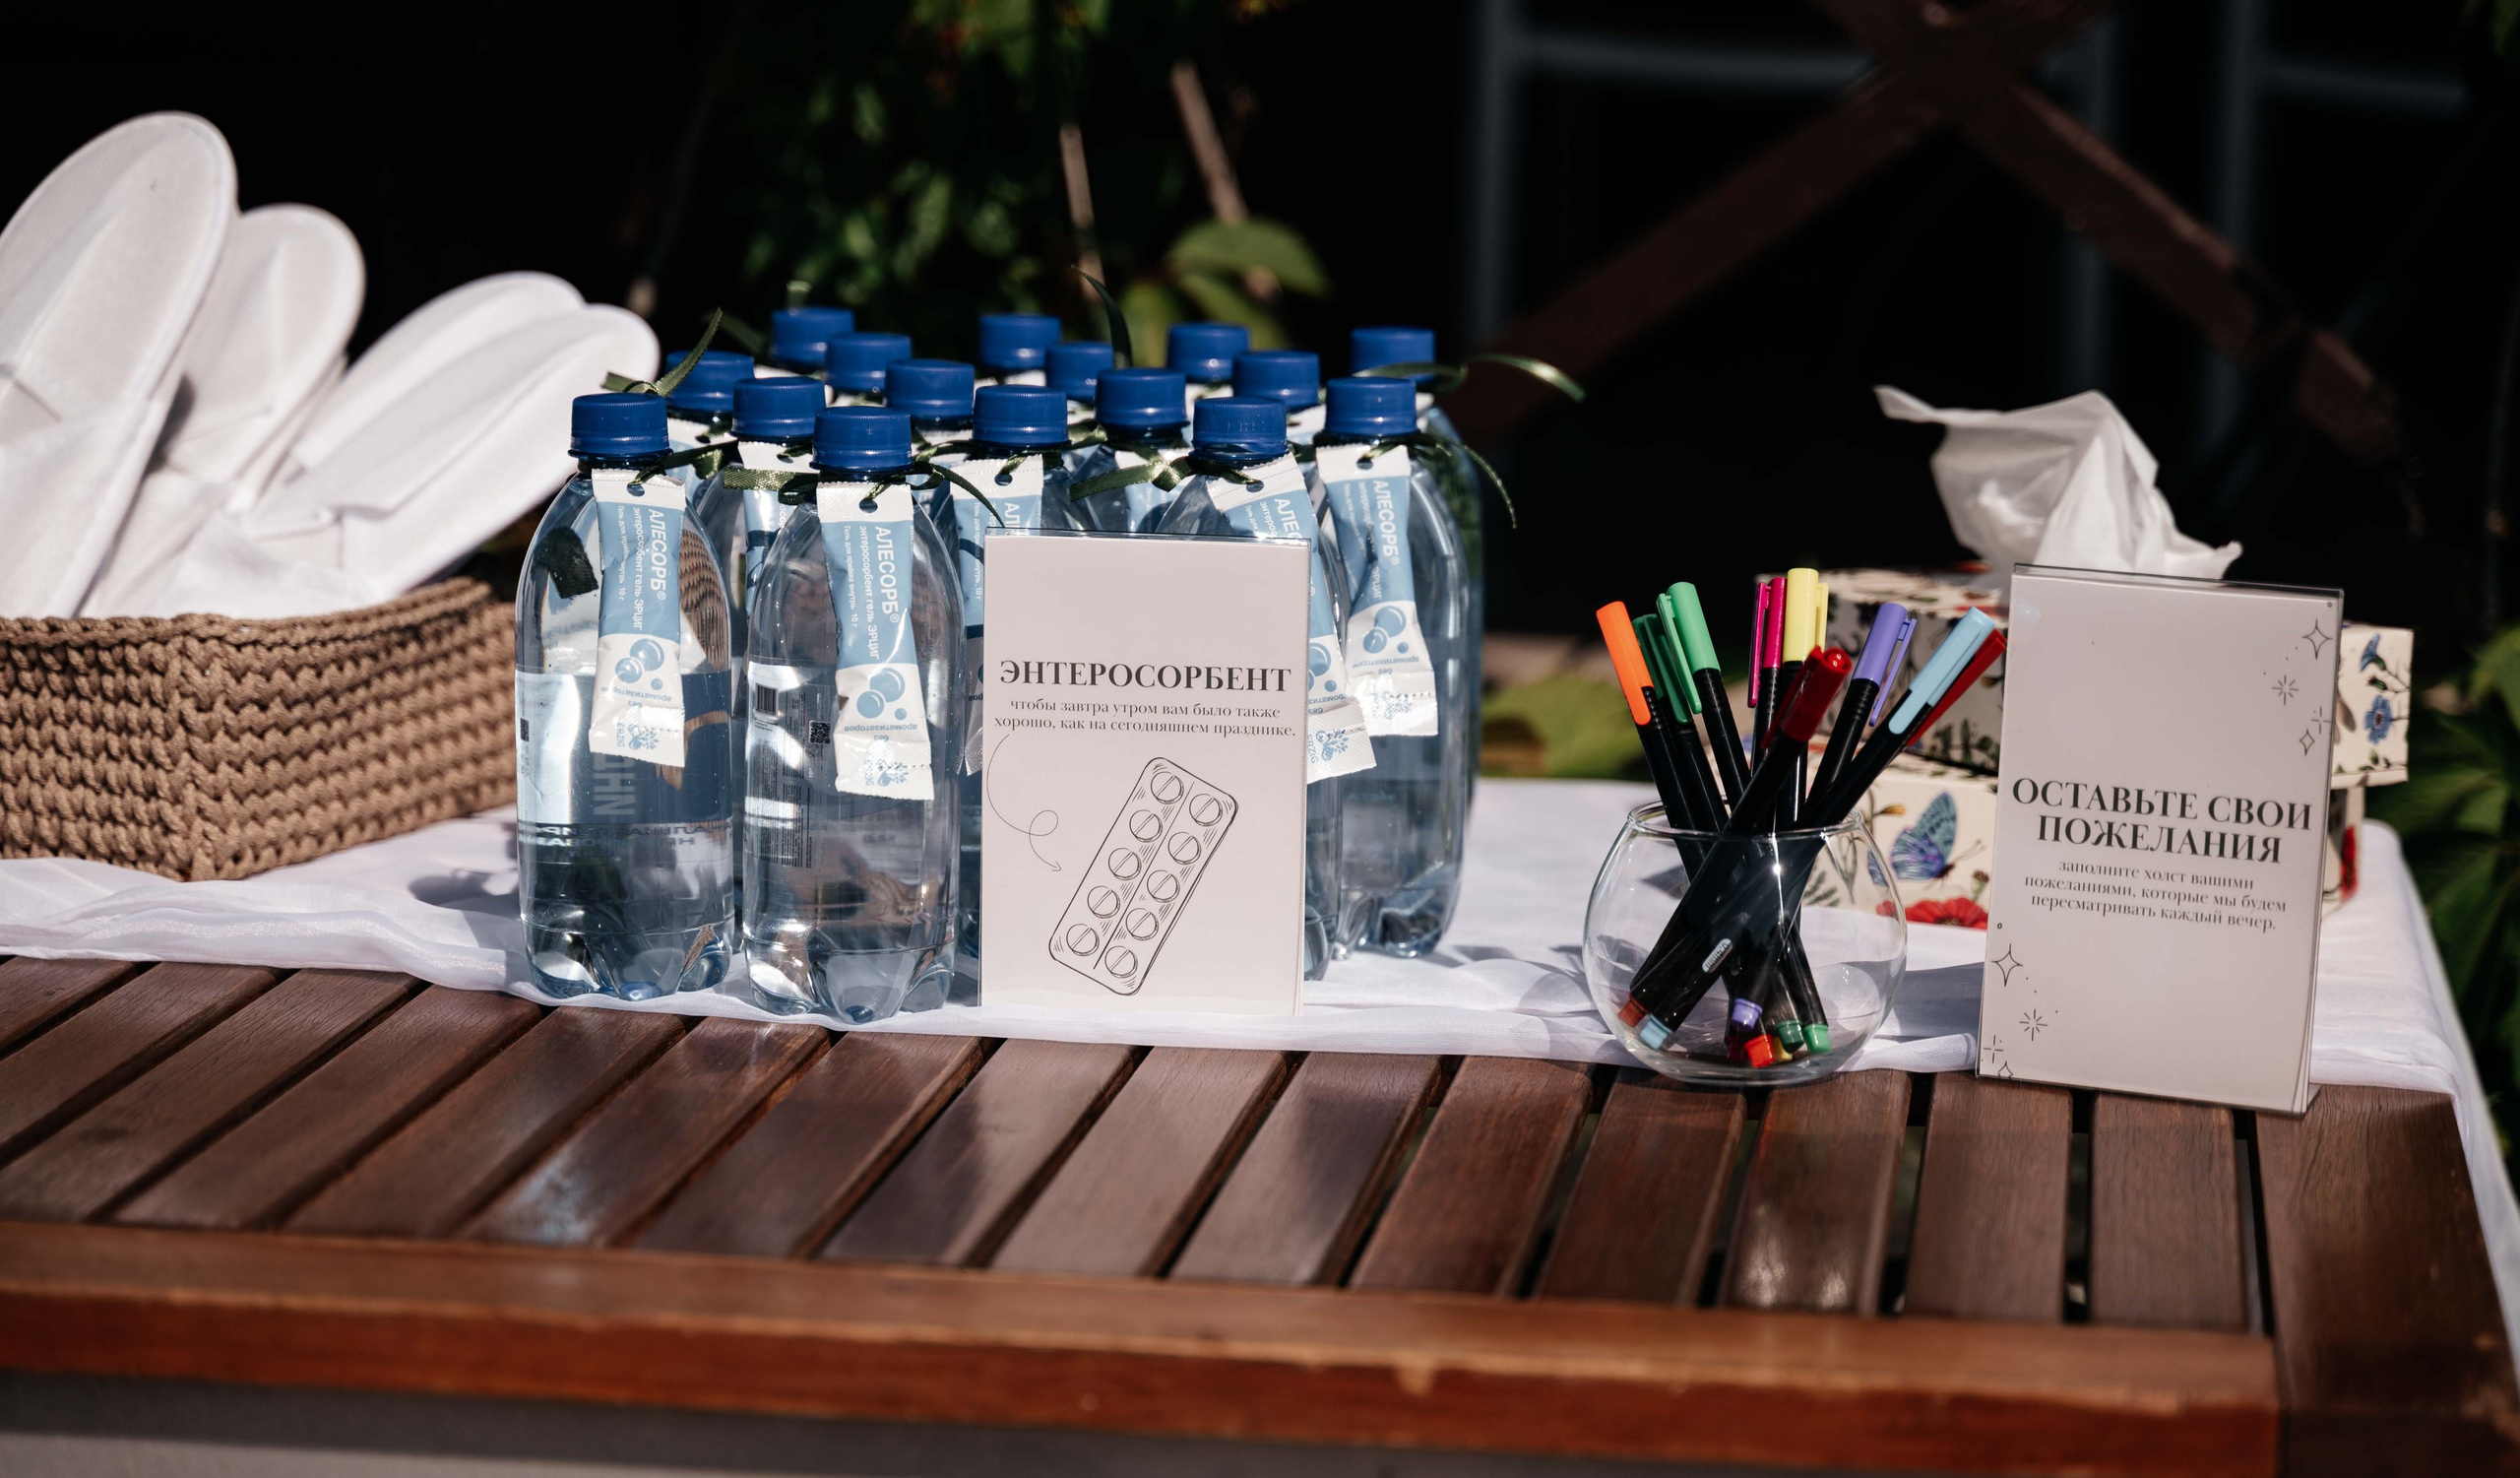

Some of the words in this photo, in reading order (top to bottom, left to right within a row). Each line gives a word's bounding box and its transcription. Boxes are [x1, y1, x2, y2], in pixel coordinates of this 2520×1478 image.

[859, 526, 873, 597] энтеросорбент
[618, 587, 626, 596] 10
[634, 575, 643, 596] гель
[632, 600, 644, 630] ЭРЦИГ
[851, 613, 858, 622] 10
[865, 600, 874, 622] гель
[867, 624, 879, 660] ЭРЦИГ
[1000, 660, 1292, 692] ЭНТЕРОСОРБЕНТ
[600, 686, 671, 702] ароматизаторв
[1010, 698, 1056, 711] чтобы
[1060, 701, 1109, 714] завтра
[1113, 703, 1158, 717] утром
[1163, 704, 1188, 715] вам
[1192, 703, 1231, 717] было
[1235, 707, 1281, 718] также
[994, 718, 1056, 730] хорошо,
[1060, 719, 1085, 729] как
[1090, 720, 1106, 730] на
[1110, 720, 1209, 735] сегодняшнем
[1214, 724, 1296, 738] празднике.
[2012, 777, 2198, 820] ОСТАВЬТЕ
[2207, 796, 2312, 831] СВОИ
[2037, 814, 2283, 865] ПОЖЕЛАНИЯ
[2058, 861, 2139, 879] заполните
[2144, 868, 2186, 883] холст
[2191, 873, 2254, 890] вашими
[2025, 874, 2136, 899] пожеланиями,
[2141, 887, 2209, 906] которые
[2213, 893, 2236, 908] мы
[2240, 895, 2287, 913] будем
[2031, 893, 2156, 918] пересматривать
[2160, 908, 2223, 926] каждый
[2227, 914, 2276, 932] вечер.
